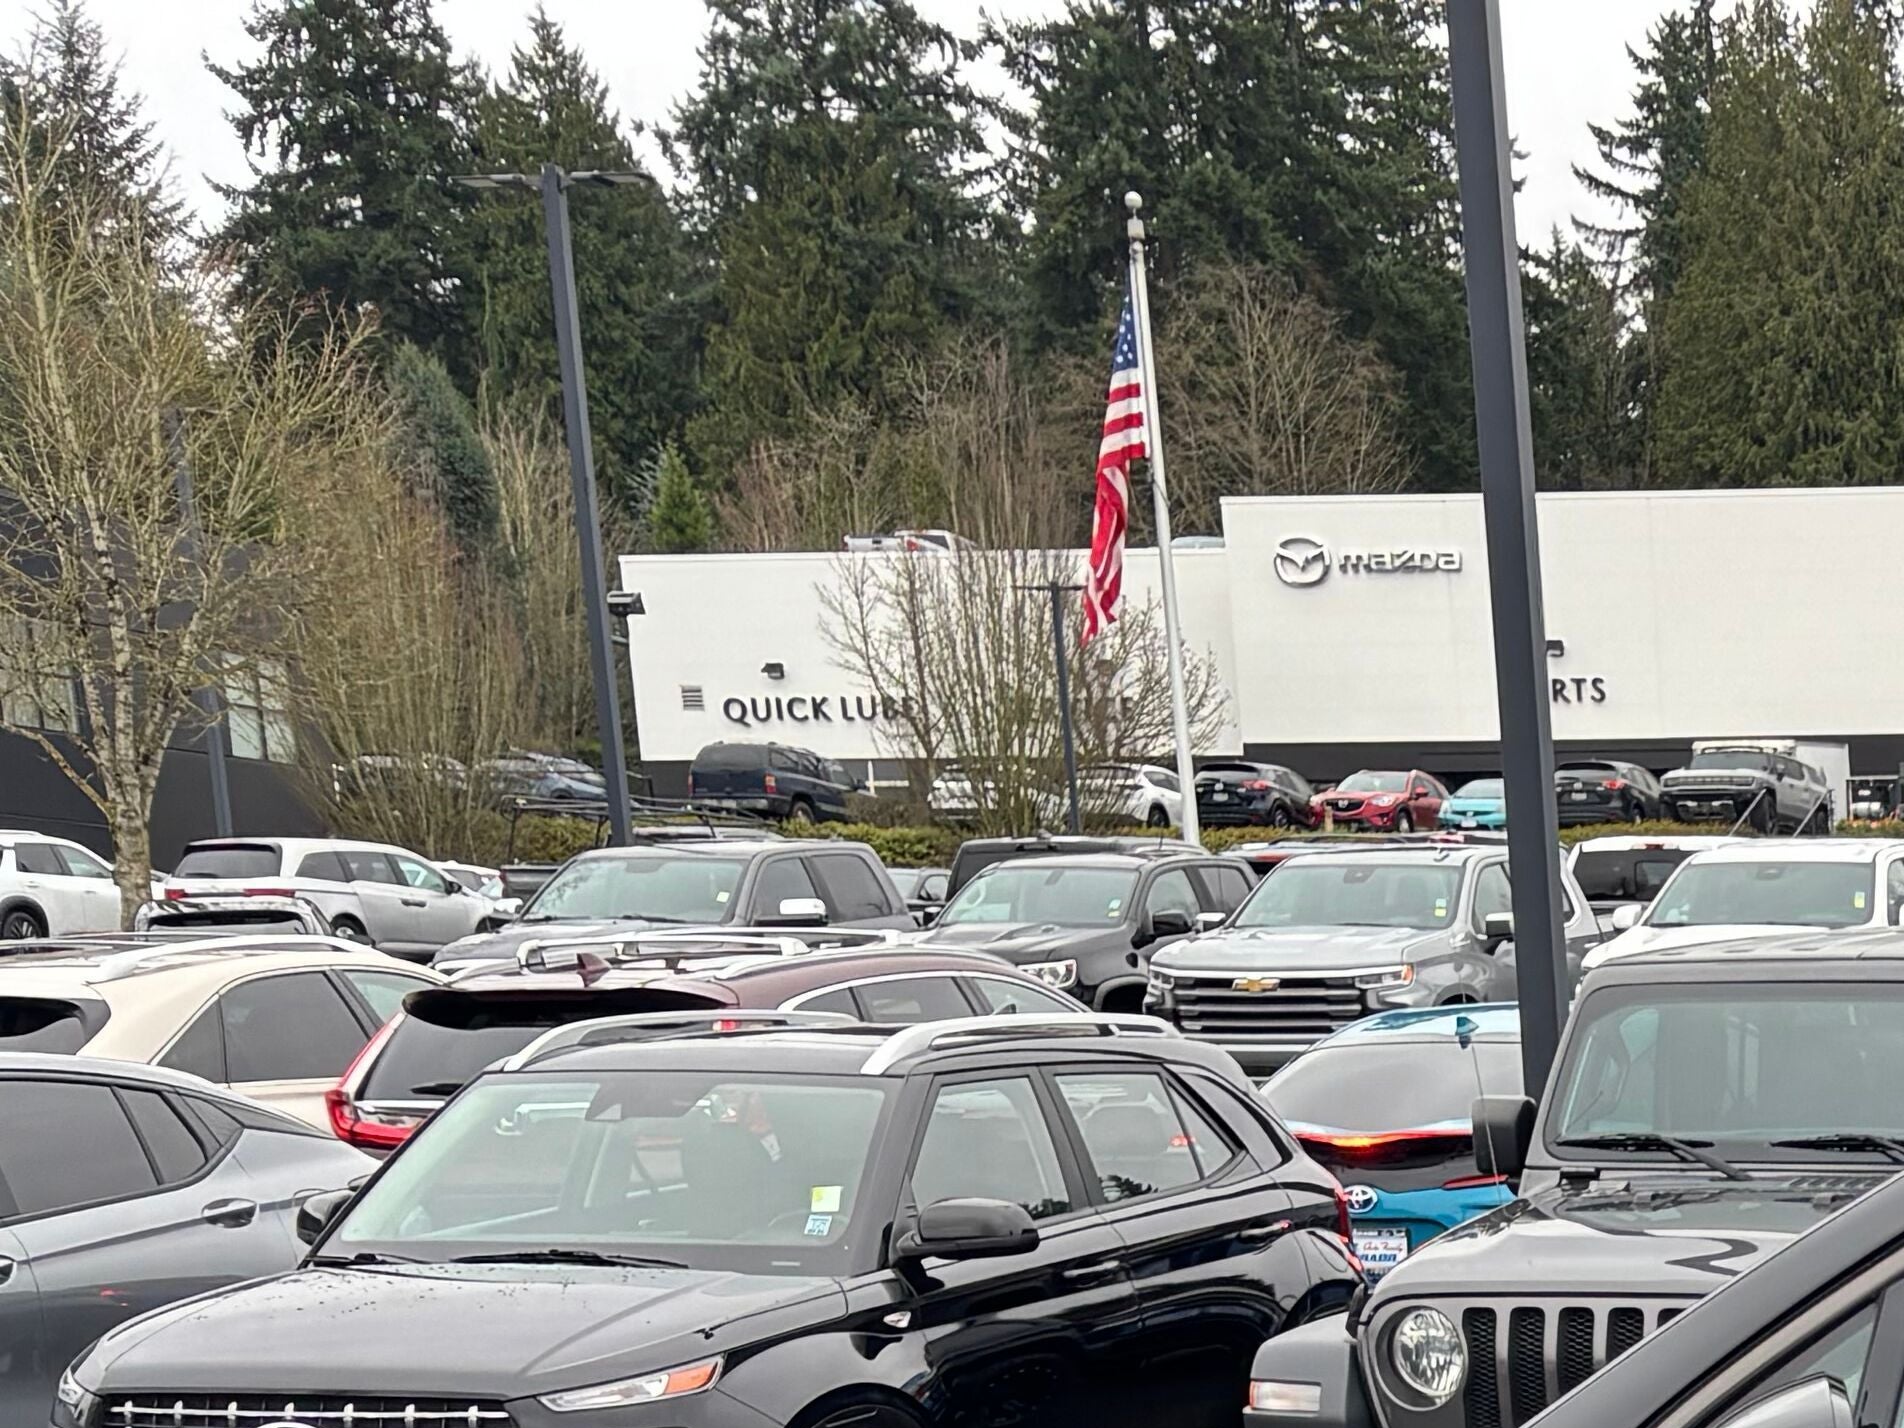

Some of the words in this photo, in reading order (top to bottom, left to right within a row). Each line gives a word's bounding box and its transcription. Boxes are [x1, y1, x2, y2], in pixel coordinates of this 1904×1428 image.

[1339, 548, 1463, 574] mazda
[1551, 677, 1607, 704] RTS
[722, 696, 833, 727] QUICK
